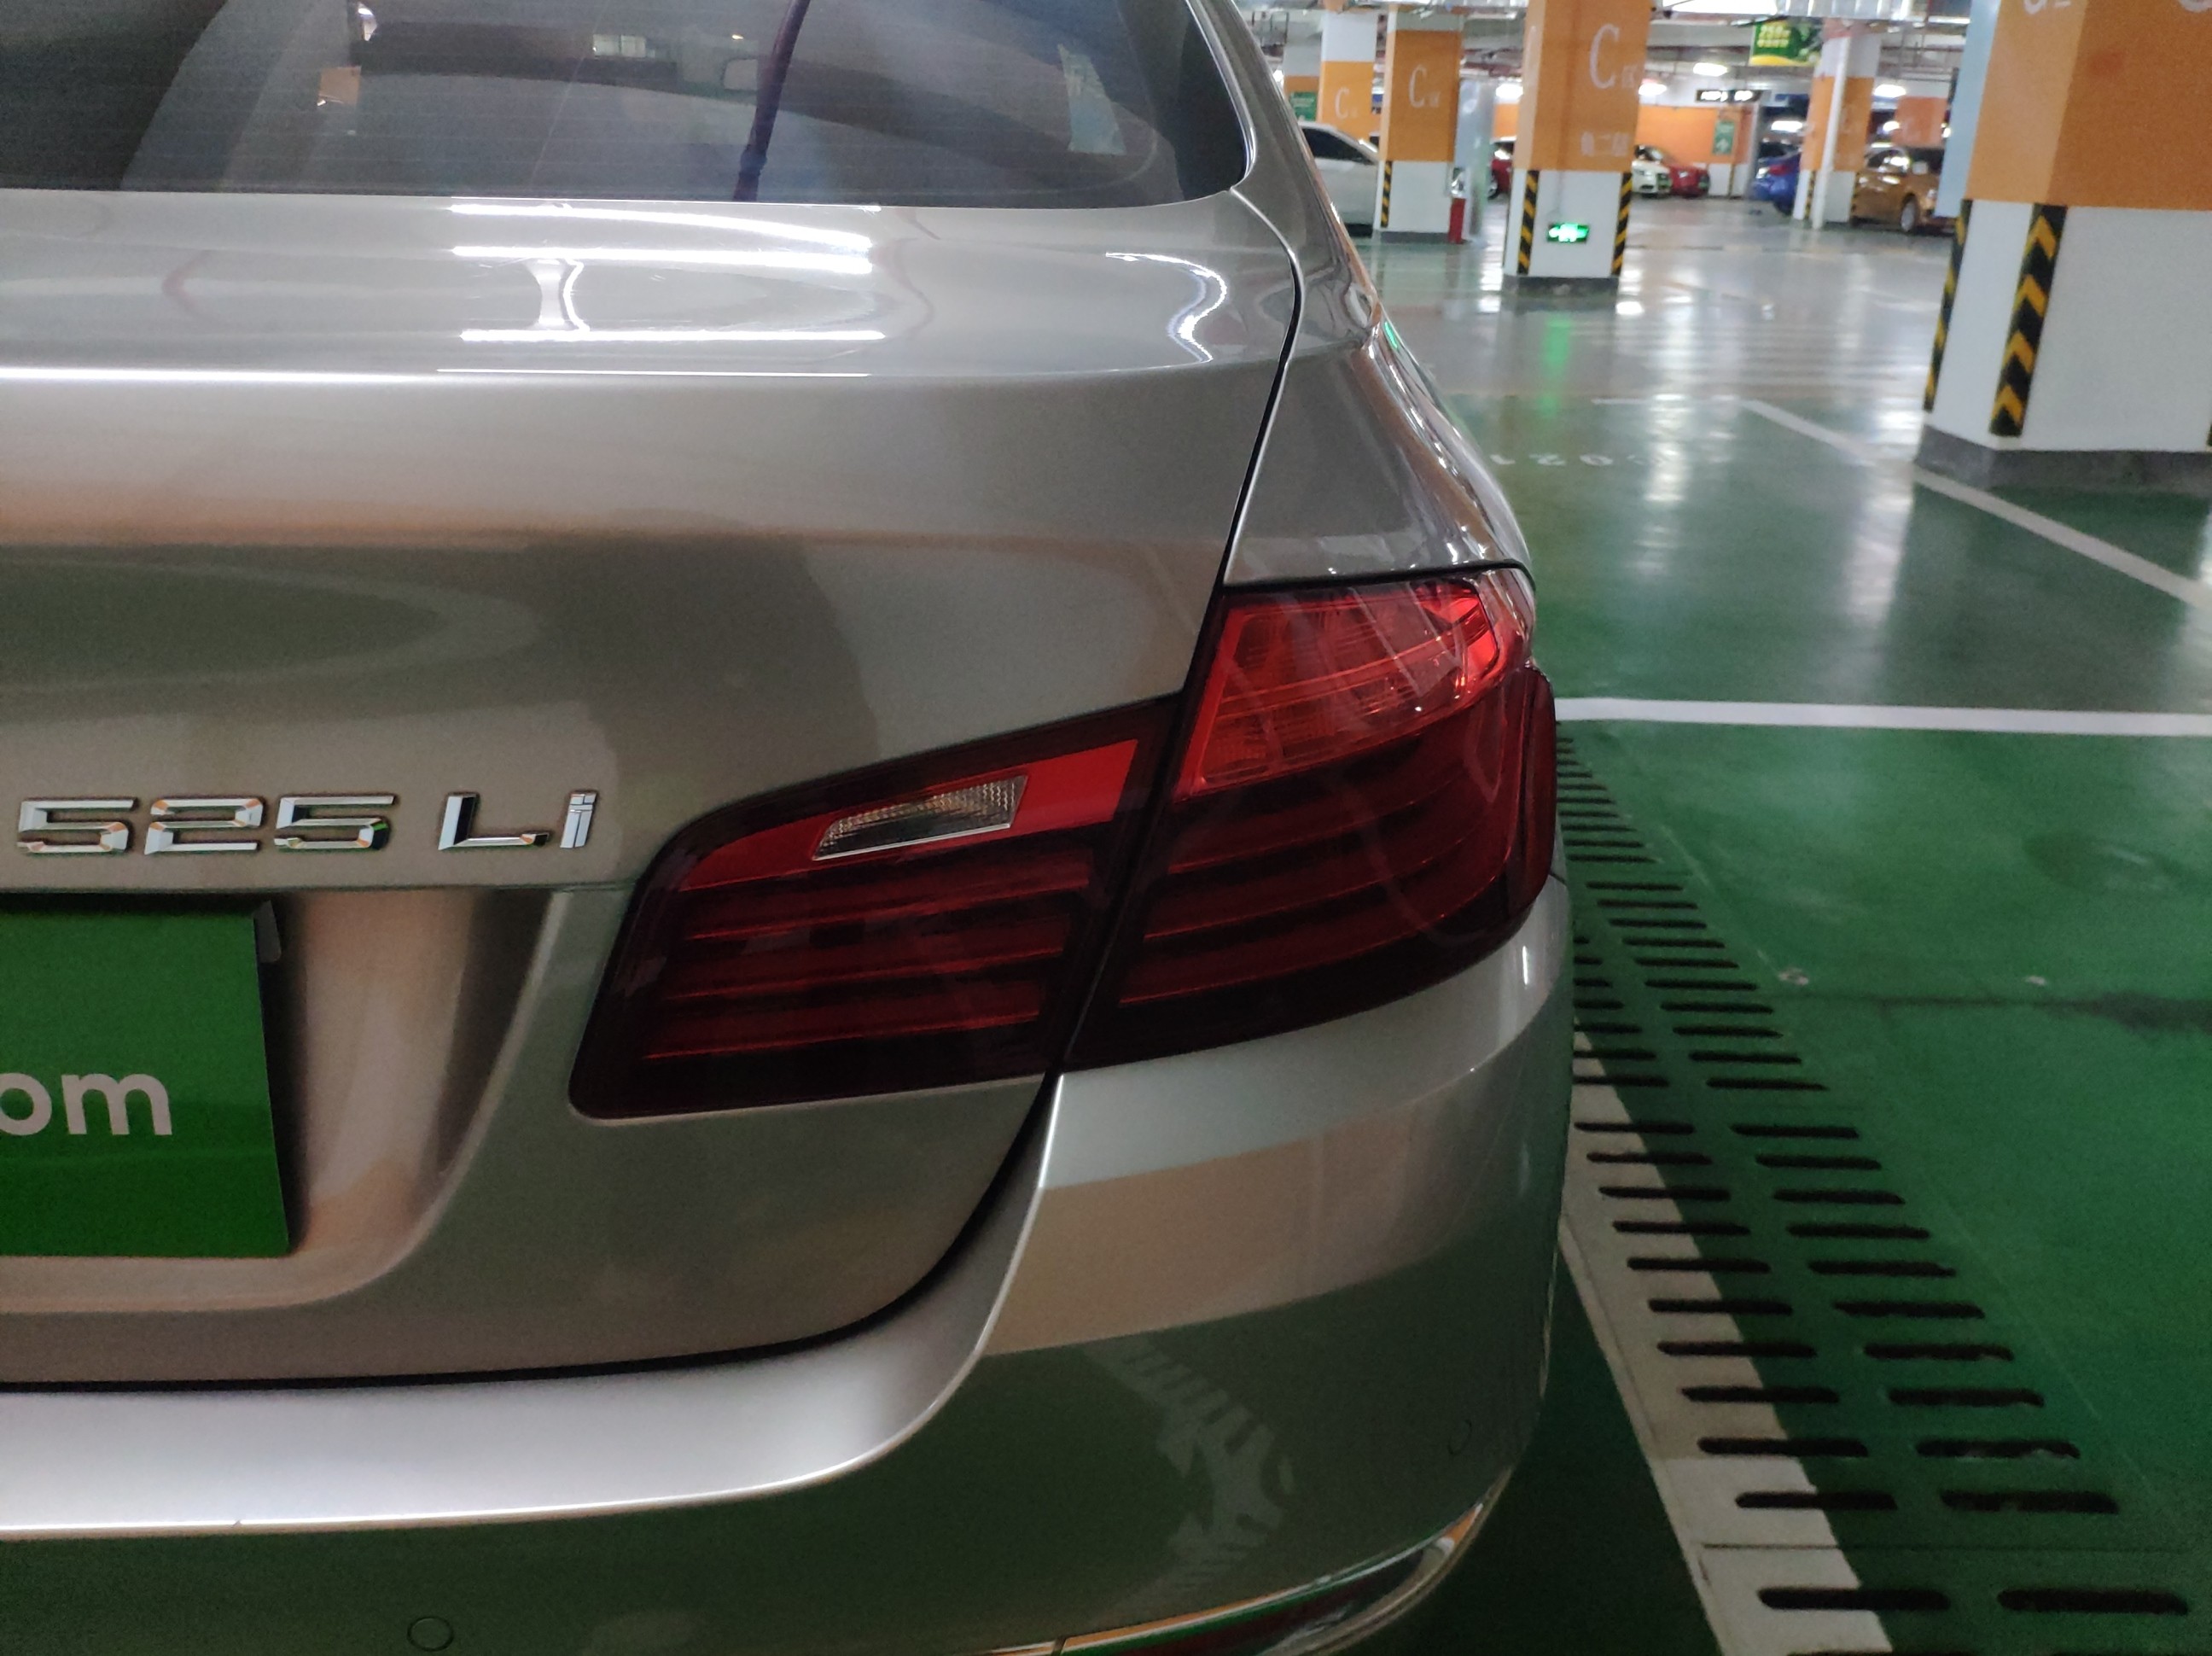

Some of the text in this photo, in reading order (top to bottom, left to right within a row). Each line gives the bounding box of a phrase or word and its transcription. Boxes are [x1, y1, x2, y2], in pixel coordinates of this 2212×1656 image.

[17, 790, 599, 856] 525 Li
[0, 1073, 173, 1136] om
